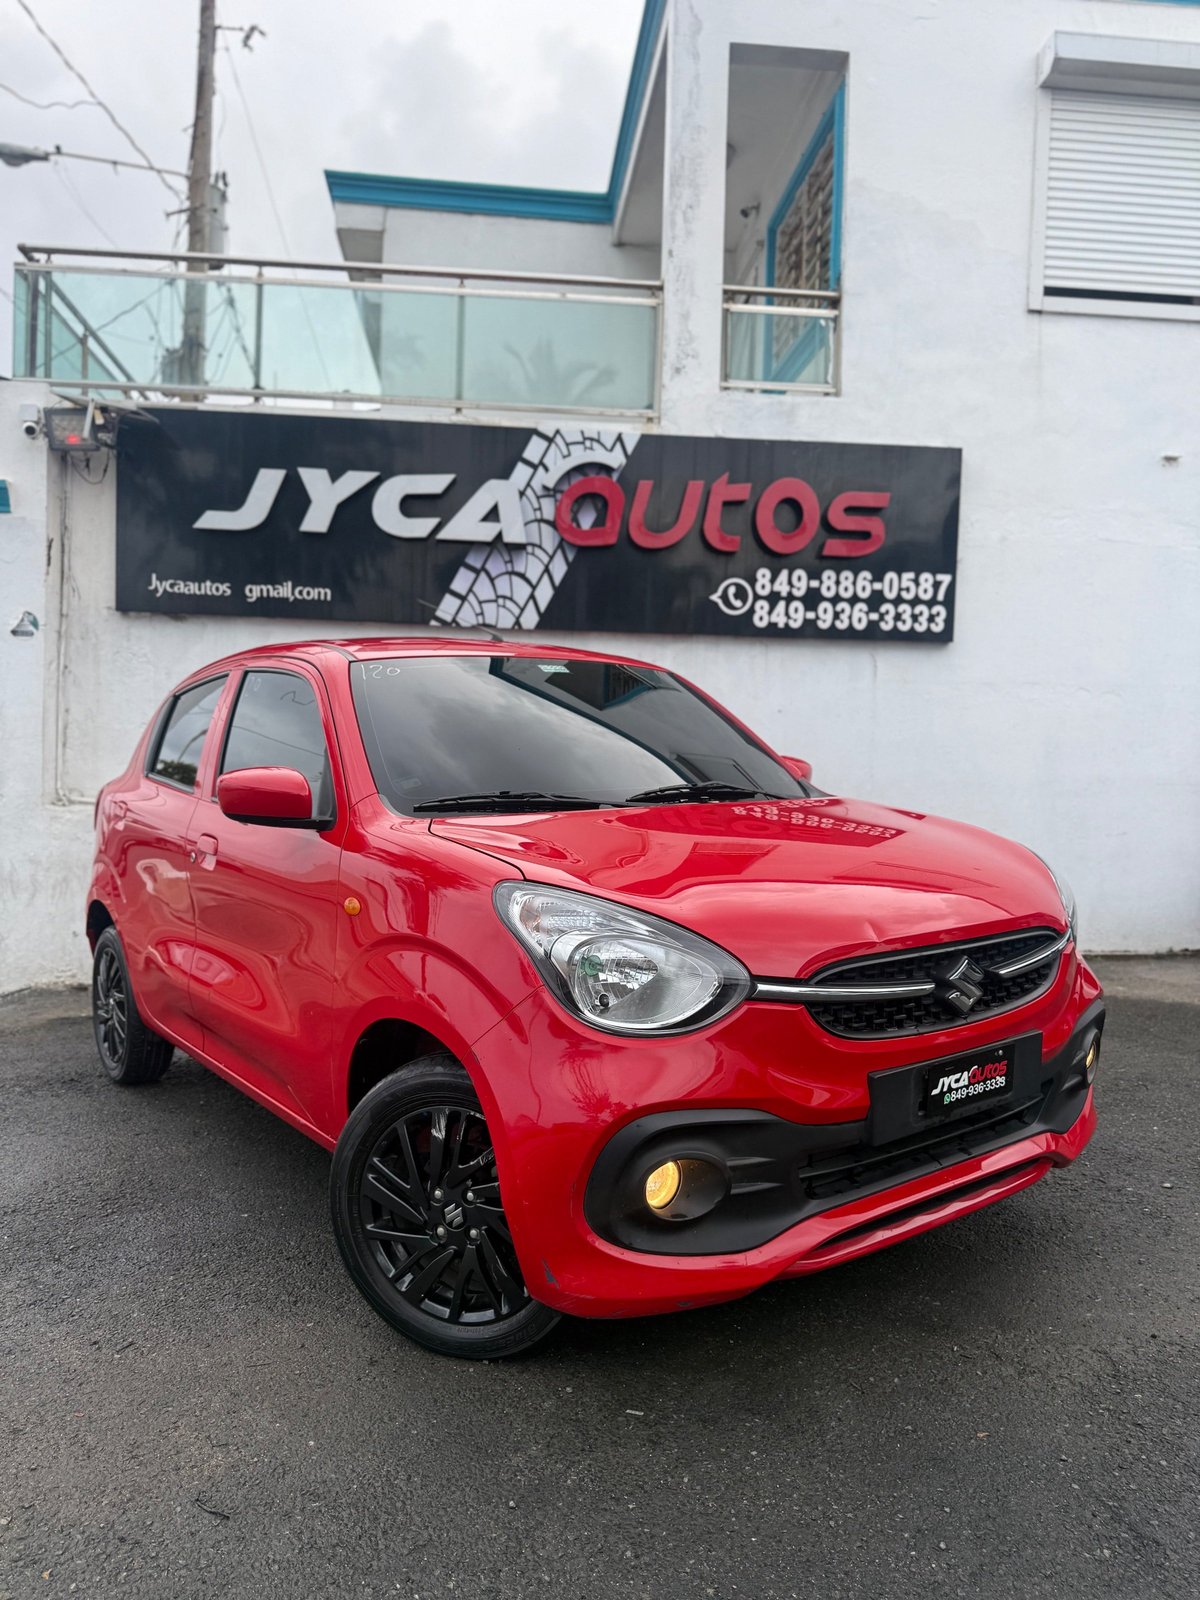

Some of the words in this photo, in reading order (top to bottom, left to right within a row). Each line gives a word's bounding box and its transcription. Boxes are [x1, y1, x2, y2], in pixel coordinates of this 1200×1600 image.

[192, 466, 527, 544] JYCA
[148, 572, 232, 598] Jycaautos
[754, 567, 953, 602] 849-886-0587
[752, 599, 948, 633] 849-936-3333
[930, 1070, 969, 1096] JYCA
